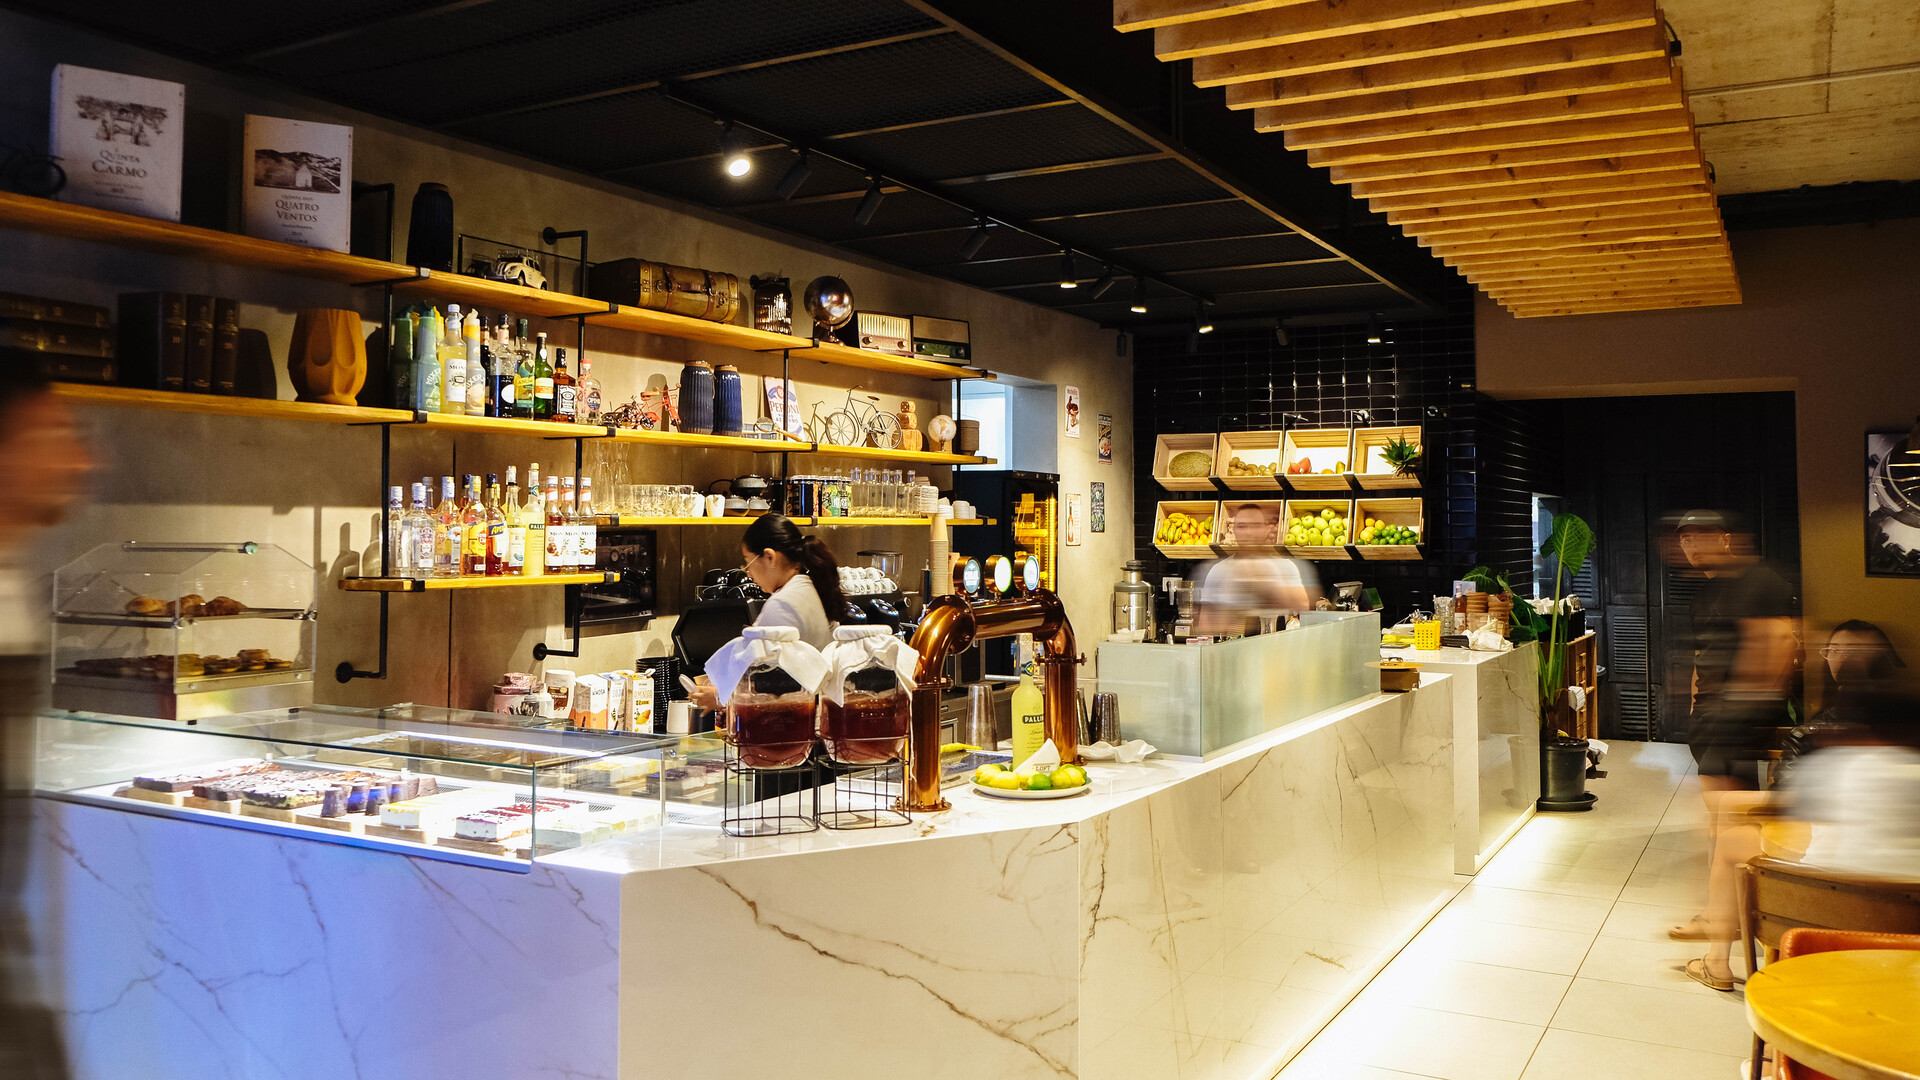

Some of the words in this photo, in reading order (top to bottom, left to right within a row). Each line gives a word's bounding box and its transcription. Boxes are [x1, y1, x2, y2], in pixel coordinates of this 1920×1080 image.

[100, 149, 140, 163] QUINTA
[92, 160, 148, 178] CARMO
[275, 200, 319, 211] QUATRO
[276, 211, 318, 222] VENTOS
